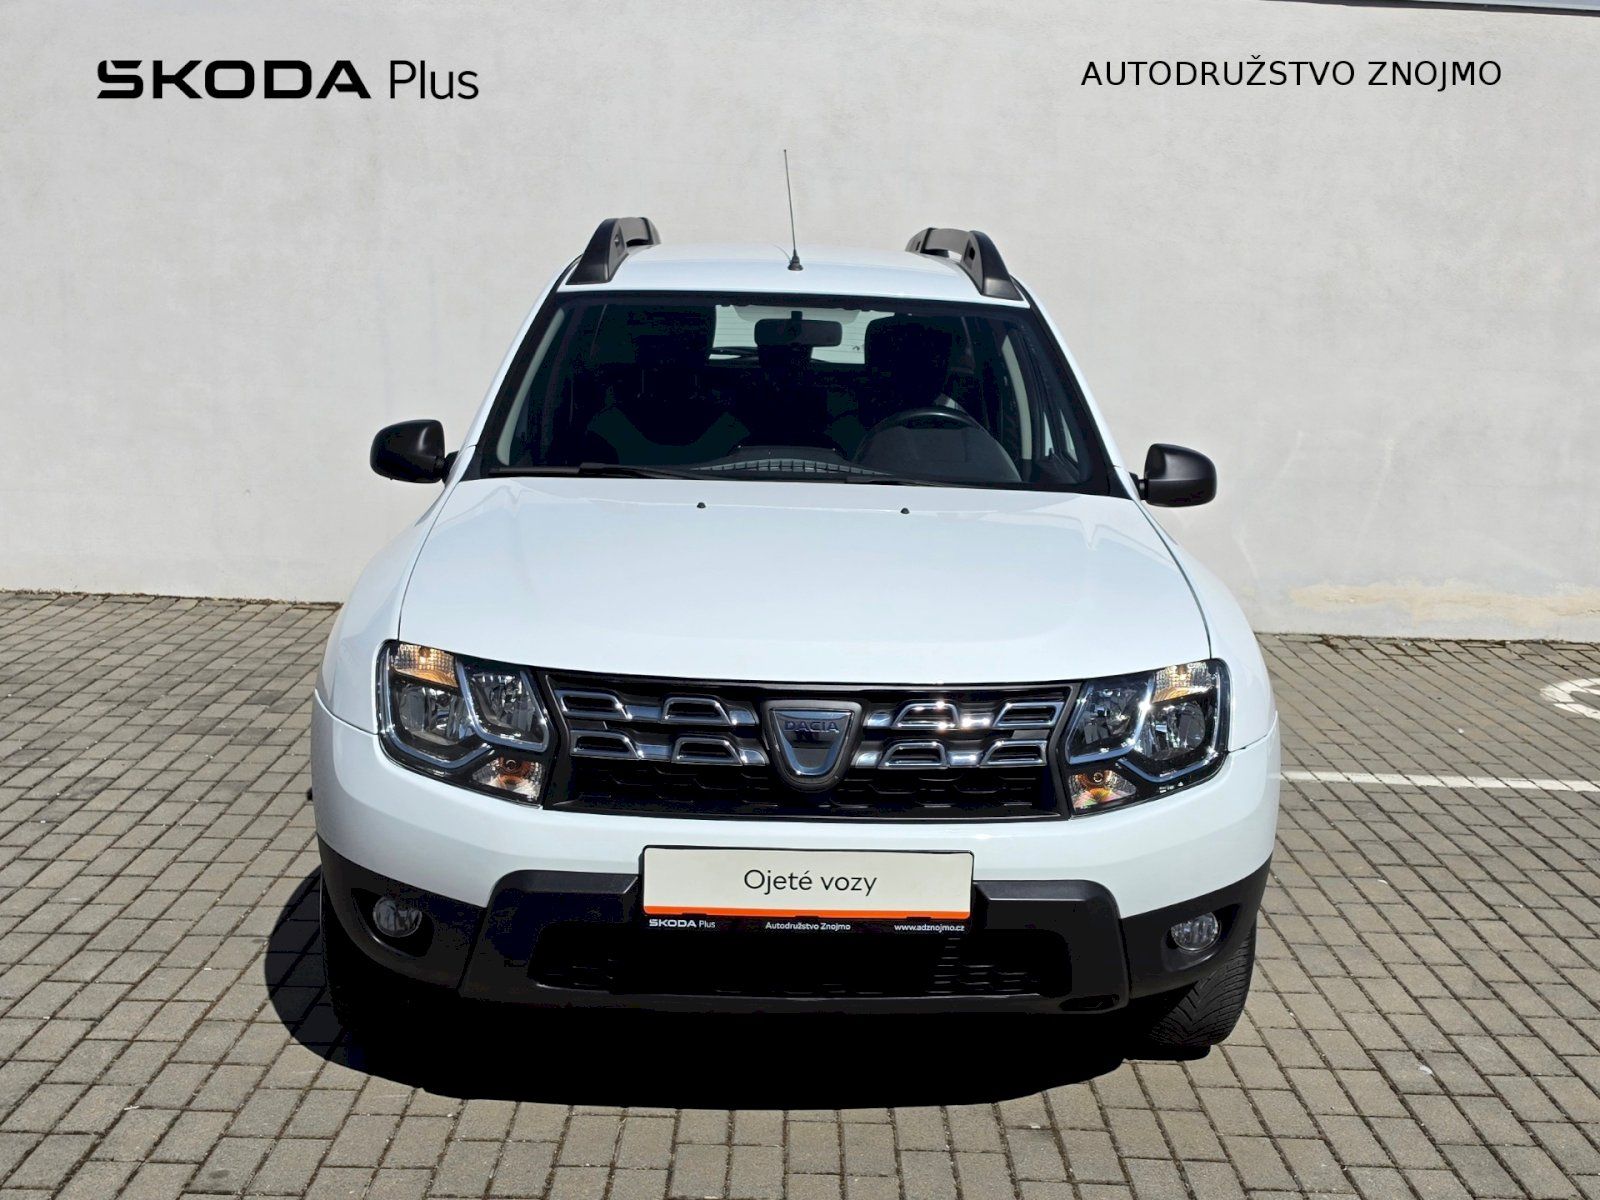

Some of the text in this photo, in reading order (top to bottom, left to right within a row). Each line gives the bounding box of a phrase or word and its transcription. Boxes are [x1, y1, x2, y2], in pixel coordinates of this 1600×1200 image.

[783, 720, 840, 733] DACIA
[743, 869, 878, 897] Ojeté vozy
[698, 919, 716, 929] Plus
[765, 921, 851, 932] Autodružstvo Znojmo
[893, 923, 966, 933] www.adznojmo.cz
